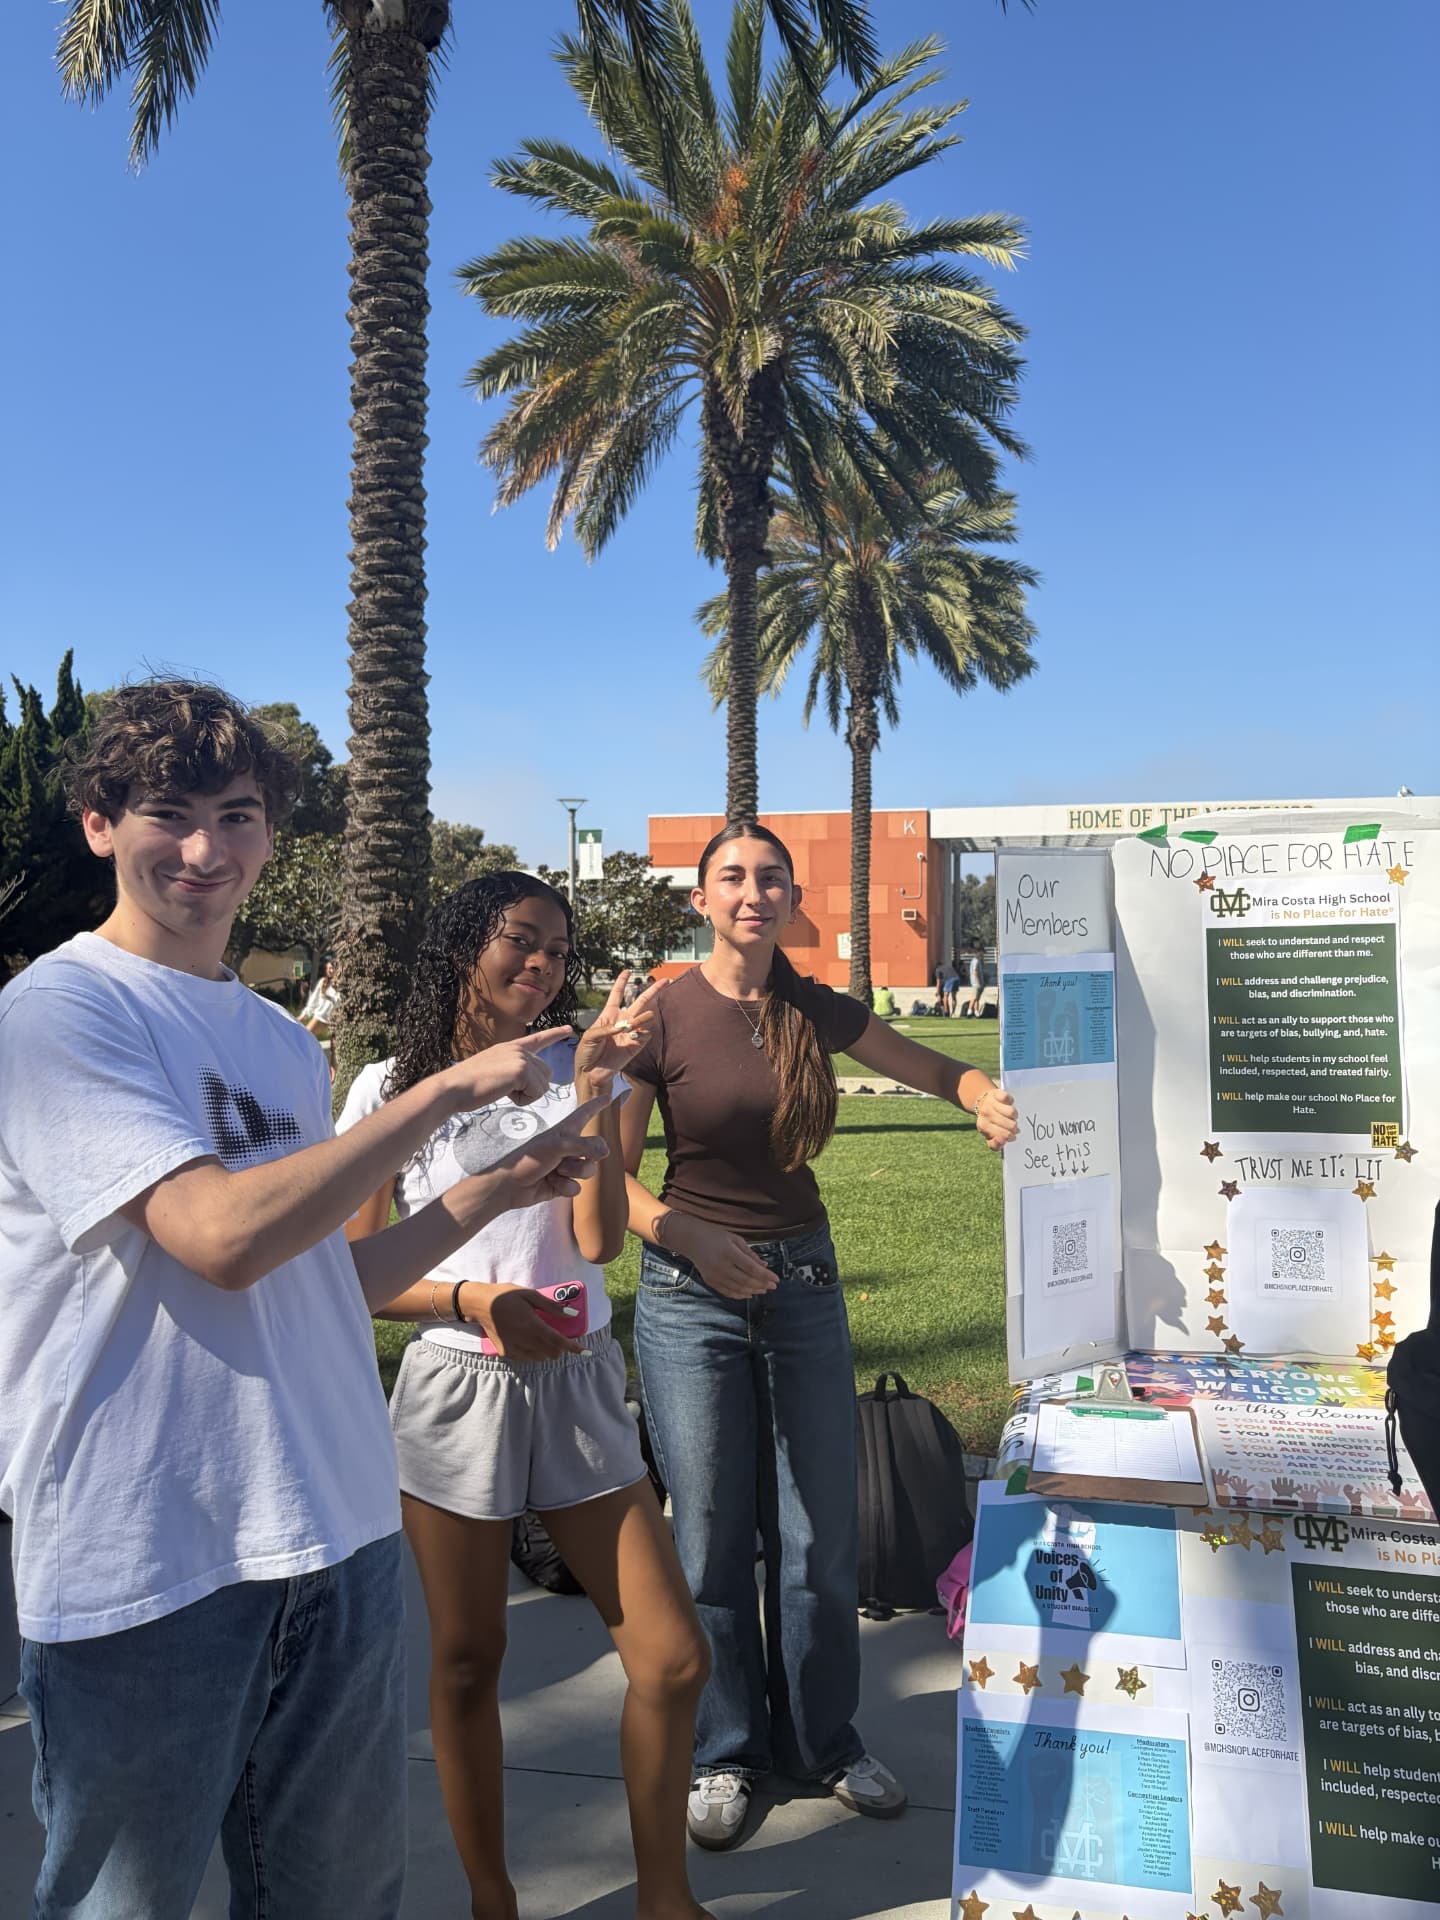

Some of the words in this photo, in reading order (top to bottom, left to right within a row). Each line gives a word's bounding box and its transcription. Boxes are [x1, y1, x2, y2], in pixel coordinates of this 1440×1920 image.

[1069, 810, 1122, 829] HOME
[1130, 809, 1152, 827] OF
[903, 820, 916, 835] K
[1151, 849, 1194, 878] NO
[1288, 843, 1332, 871] FOR
[1344, 841, 1414, 868] HATE
[1018, 874, 1060, 898] Our
[1253, 896, 1278, 906] Mira
[1282, 896, 1315, 905] Costa
[1319, 894, 1346, 906] High
[1349, 893, 1390, 904] School
[1006, 898, 1088, 937] Members
[1271, 911, 1280, 919] is
[1284, 910, 1300, 919] No
[1303, 909, 1335, 918] Place
[1338, 908, 1357, 917] for
[1223, 938, 1244, 947] WILL
[1246, 938, 1266, 946] seek
[1280, 936, 1330, 945] understand
[1332, 936, 1349, 944] and
[1351, 935, 1385, 944] respect
[1230, 951, 1254, 960] those
[1256, 951, 1275, 959] who
[1293, 950, 1332, 958] different
[1334, 949, 1354, 957] than
[1357, 949, 1373, 957] me.
[1221, 977, 1242, 986] WILL
[1245, 976, 1279, 985] address
[1281, 976, 1297, 984] and
[1299, 975, 1342, 986] challenge
[1344, 974, 1388, 984] prejudice,
[1249, 990, 1269, 999] bias,
[1271, 989, 1288, 998] and
[1290, 989, 1356, 998] discrimination.
[1218, 1016, 1240, 1024] WILL
[1282, 1015, 1297, 1026] ally
[1300, 1016, 1309, 1024] to
[1311, 1016, 1346, 1026] support
[1348, 1014, 1373, 1023] those
[1375, 1015, 1393, 1023] who
[1237, 1029, 1267, 1039] targets
[1269, 1028, 1279, 1037] of
[1280, 1028, 1300, 1038] bias,
[1303, 1028, 1341, 1039] bullying,
[1344, 1028, 1363, 1038] and,
[1365, 1028, 1387, 1036] hate.
[1250, 1055, 1269, 1064] help
[1272, 1055, 1310, 1063] students
[1312, 1055, 1320, 1063] in
[1323, 1056, 1336, 1065] my
[1338, 1055, 1368, 1063] school
[1371, 1055, 1388, 1063] feel
[1220, 1067, 1260, 1076] included,
[1262, 1068, 1308, 1077] respected,
[1310, 1068, 1327, 1076] and
[1329, 1068, 1363, 1076] treated
[1365, 1068, 1391, 1078] fairly.
[1221, 1092, 1243, 1100] WILL
[1245, 1093, 1264, 1102] help
[1266, 1093, 1289, 1101] make
[1308, 1093, 1338, 1102] school
[1340, 1094, 1353, 1102] No
[1355, 1094, 1380, 1103] Place
[1382, 1094, 1396, 1103] for
[1293, 1106, 1316, 1114] Hate.
[511, 1117, 527, 1131] 5
[1026, 1113, 1054, 1141] You
[1373, 1125, 1385, 1135] NO
[1373, 1136, 1397, 1146] HATE
[1056, 1142, 1090, 1161] this
[1292, 1160, 1313, 1178] ME
[1355, 1157, 1382, 1180] LIT
[1187, 1369, 1357, 1383] EVERYONE
[1195, 1380, 1367, 1397] WELCOME
[1214, 1404, 1242, 1412] in
[1244, 1401, 1290, 1418] this
[1297, 1408, 1384, 1421] Room
[1268, 1419, 1332, 1428] BELONG
[1272, 1426, 1334, 1434] MATTER
[1309, 1435, 1366, 1444] WORTH
[1323, 1465, 1390, 1474] VALUED
[1351, 1527, 1387, 1542] Mira
[1390, 1530, 1437, 1546] Costa
[1035, 1549, 1078, 1566] Voices
[1377, 1548, 1390, 1561] is
[1394, 1550, 1417, 1563] No
[1050, 1568, 1063, 1583] of
[1035, 1585, 1068, 1602] Unity
[1309, 1579, 1312, 1591] I
[1315, 1580, 1344, 1594] WILL
[1346, 1585, 1374, 1597] seek
[1376, 1588, 1389, 1598] to
[1326, 1601, 1359, 1614] those
[1362, 1606, 1387, 1618] who
[1390, 1608, 1409, 1619] are
[1309, 1637, 1312, 1648] I
[1316, 1638, 1345, 1652] WILL
[1348, 1642, 1395, 1657] address
[1398, 1647, 1420, 1660] and
[1355, 1661, 1383, 1678] bias,
[1386, 1666, 1409, 1678] and
[1309, 1696, 1312, 1708] I
[1315, 1696, 1345, 1711] WILL
[1348, 1702, 1367, 1714] act
[1369, 1704, 1383, 1715] as
[1386, 1705, 1400, 1716] an
[1403, 1706, 1426, 1722] ally
[1319, 1720, 1339, 1730] are
[1341, 1720, 1385, 1737] targets
[1388, 1725, 1400, 1737] of
[1403, 1726, 1432, 1743] bias,
[1033, 1731, 1077, 1751] Thank
[1080, 1738, 1111, 1759] you!
[1204, 1742, 1300, 1761] @MCHSNOPLACEFORHATE
[1323, 1758, 1327, 1771] I
[1330, 1759, 1361, 1774] WILL
[1363, 1762, 1391, 1780] help
[1321, 1778, 1379, 1799] included,
[1319, 1820, 1322, 1833] I
[1325, 1821, 1357, 1838] WILL
[1360, 1824, 1388, 1844] help
[1391, 1831, 1424, 1846] make
